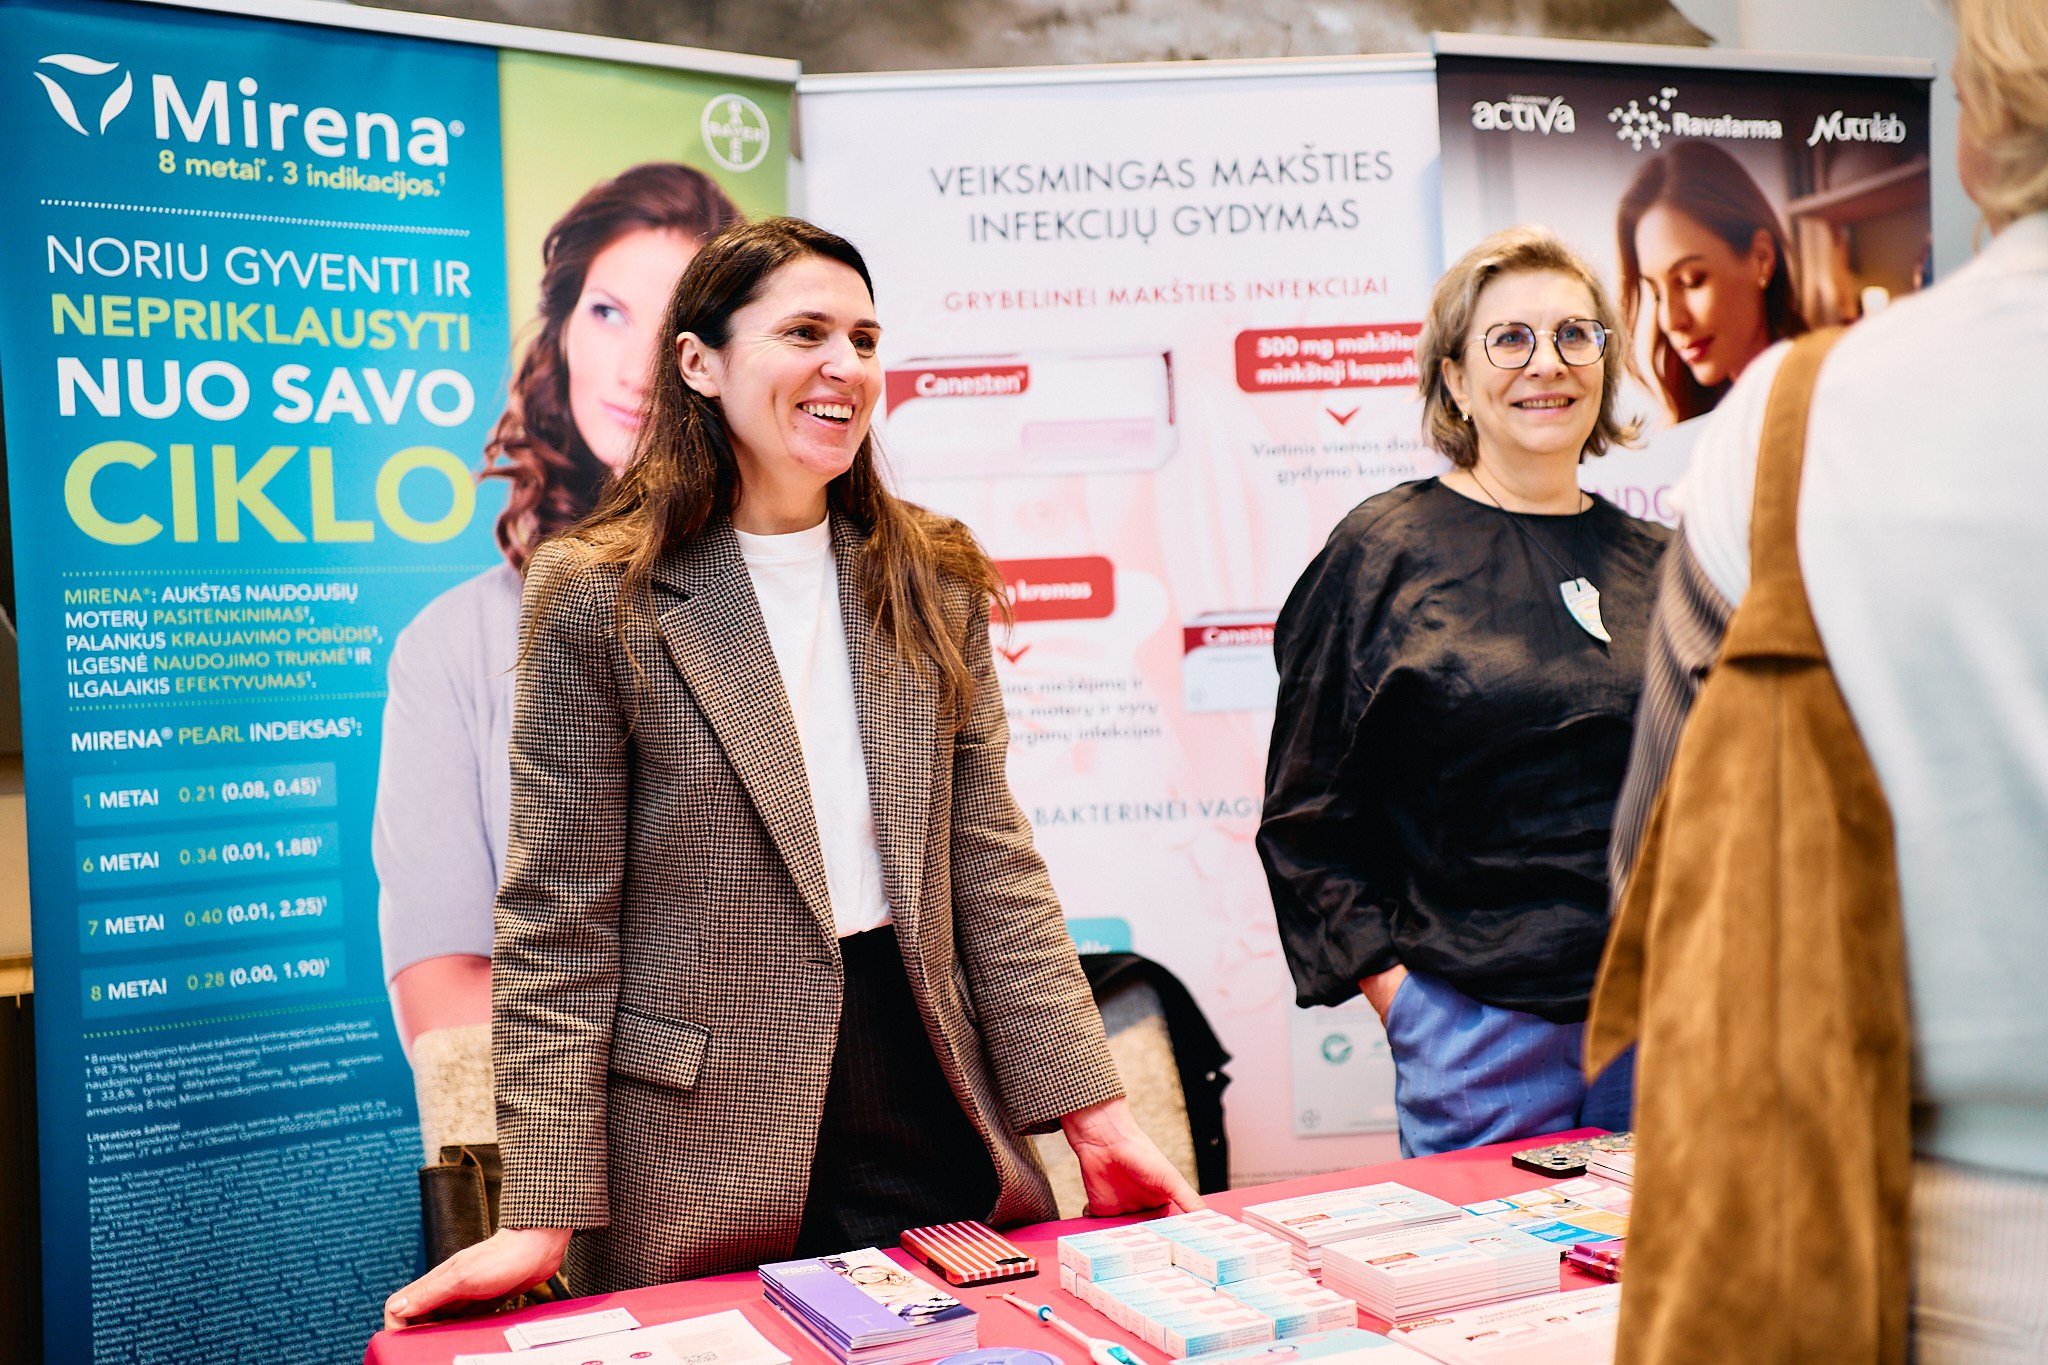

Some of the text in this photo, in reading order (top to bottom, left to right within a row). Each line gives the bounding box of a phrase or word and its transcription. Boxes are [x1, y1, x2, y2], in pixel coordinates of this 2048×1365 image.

[1672, 112, 1784, 140] Ravafarma
[1806, 110, 1907, 147] Nutrilab
[159, 149, 176, 174] 8
[282, 161, 299, 186] 3
[929, 144, 1394, 198] VEIKSMINGAS MAKŠTIES
[969, 199, 1360, 246] INFEKCIJŲ GYDYMAS
[46, 235, 472, 299] NORIU GYVENTI IR
[943, 276, 1389, 313] GRYBELINEI MAKŠTIES INFEKCIJAI
[51, 293, 471, 353] NEPRIKLAUSYTI
[1300, 338, 1334, 360] mg
[1256, 359, 1347, 386] minkštoji
[57, 357, 476, 427] NUO SAVO
[1277, 463, 1353, 486] gydymo
[64, 440, 477, 546] CIKLO
[161, 581, 242, 604] AUKŠTAS
[246, 582, 359, 604] NAUDOJUSIŲ
[65, 609, 148, 630] MOTERŲ
[66, 631, 167, 652] PALANKUS
[171, 628, 292, 649] KRAUJAVIMO
[67, 651, 149, 676] ILGESNĖ
[154, 651, 271, 672] NAUDOJIMO
[355, 646, 372, 665] IR
[68, 677, 171, 699] ILGALAIKIS
[178, 724, 246, 746] PEARL
[83, 793, 92, 809] 1
[99, 788, 159, 809] METAI
[178, 785, 215, 803] 0.21
[1034, 799, 1188, 828] BAKTERINEI
[82, 857, 94, 873] 6
[99, 851, 160, 873] METAI
[179, 847, 218, 866] 0.34
[222, 841, 270, 865] (0.01,
[88, 920, 99, 936] 7
[105, 914, 165, 936] METAI
[184, 908, 223, 927] 0.40
[227, 902, 275, 926] (0.01,
[90, 985, 102, 1002] 8
[108, 977, 168, 1001] METAI
[187, 971, 225, 991] 0.28
[229, 964, 278, 988] (0.00,
[99, 1138, 134, 1153] Mirena
